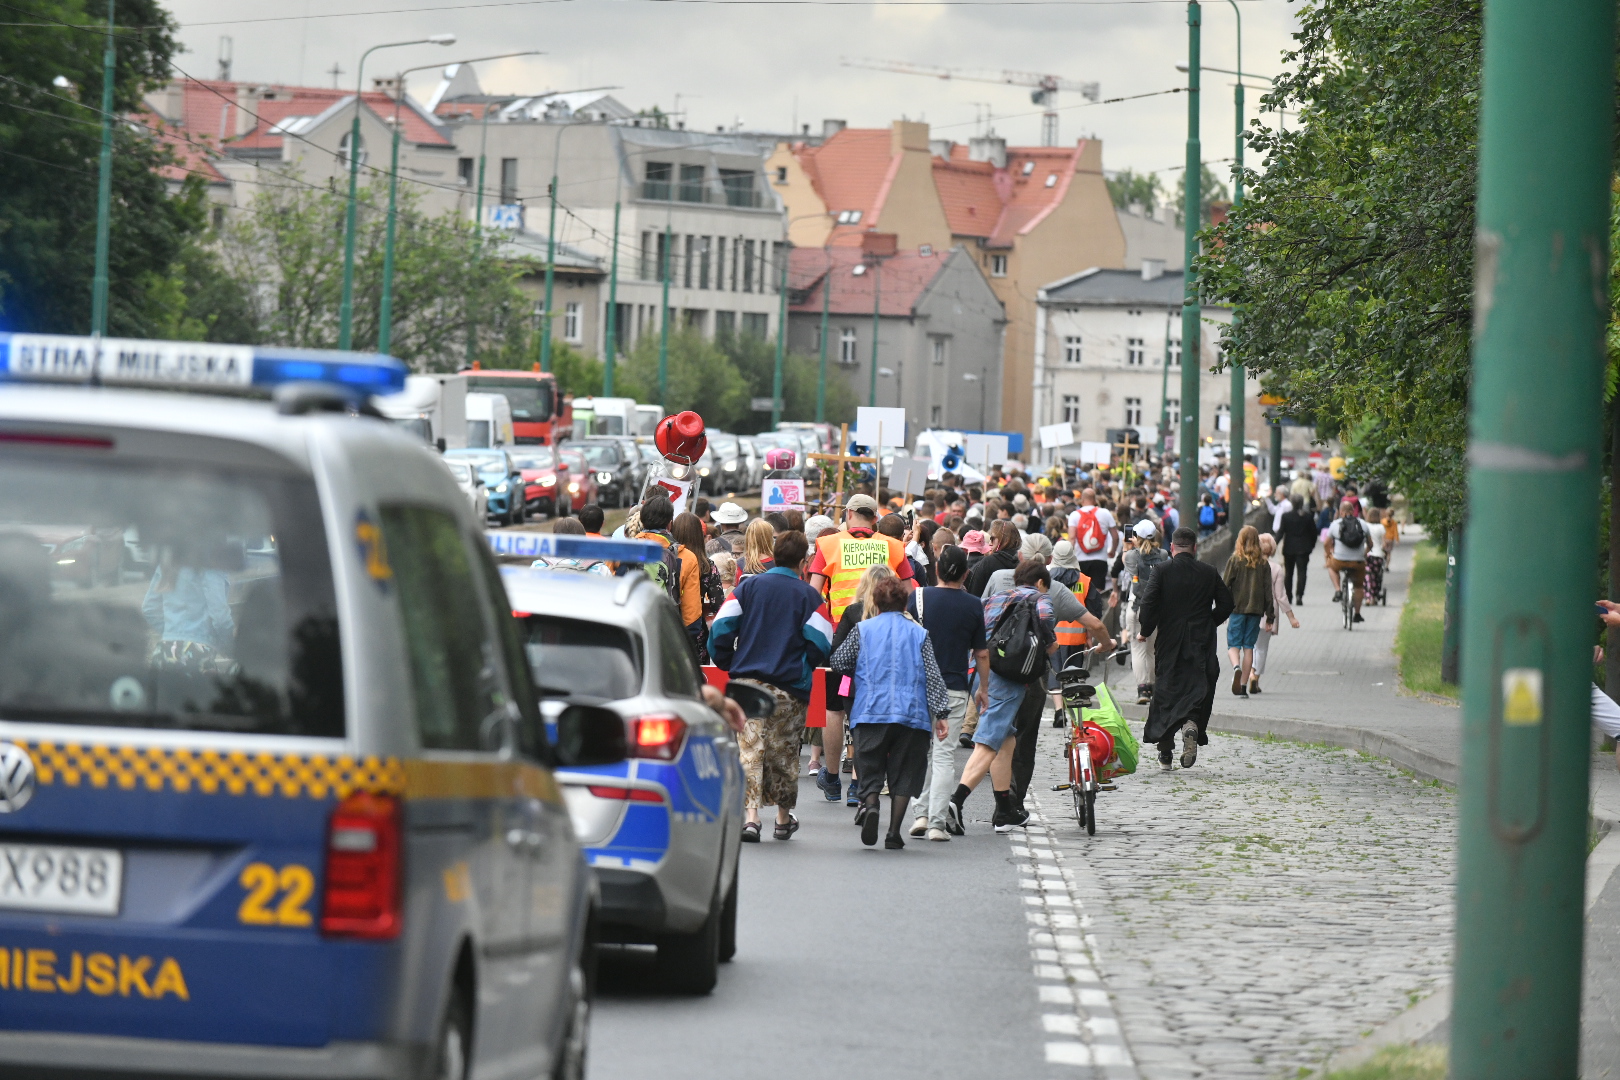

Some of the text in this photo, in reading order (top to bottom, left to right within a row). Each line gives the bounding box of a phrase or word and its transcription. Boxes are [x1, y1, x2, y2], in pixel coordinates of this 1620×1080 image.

[117, 351, 239, 375] MIEJSKA
[843, 542, 886, 553] KIEROWANIE
[844, 552, 886, 566] RUCHEM
[238, 863, 315, 926] 22
